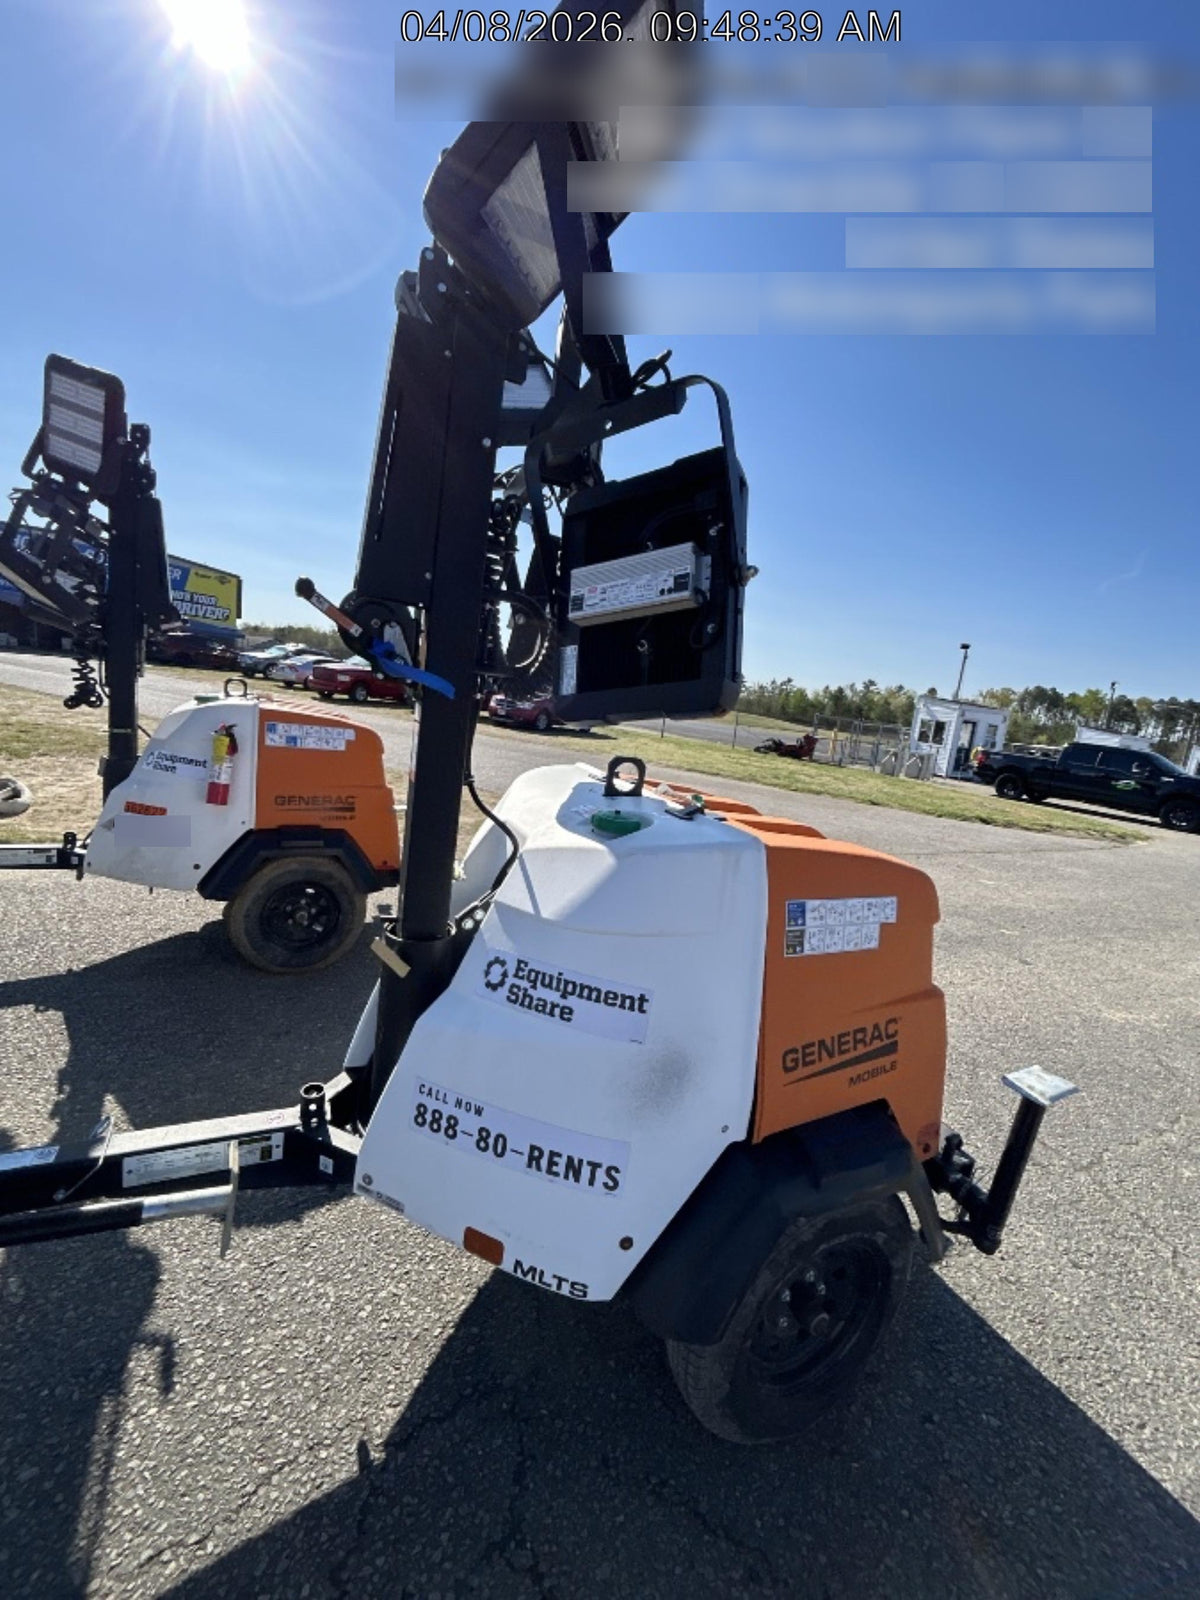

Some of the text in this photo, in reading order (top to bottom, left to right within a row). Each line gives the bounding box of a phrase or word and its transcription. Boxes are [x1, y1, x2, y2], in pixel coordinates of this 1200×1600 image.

[274, 795, 356, 806] GENERAC
[506, 982, 575, 1023] Share
[512, 958, 650, 1014] Equipment
[781, 1017, 900, 1074] GENERAC
[848, 1060, 898, 1088] MOBILE
[418, 1083, 485, 1117] CALL NOW
[413, 1102, 622, 1192] 888-80-RENTS
[512, 1259, 589, 1299] MLTS
